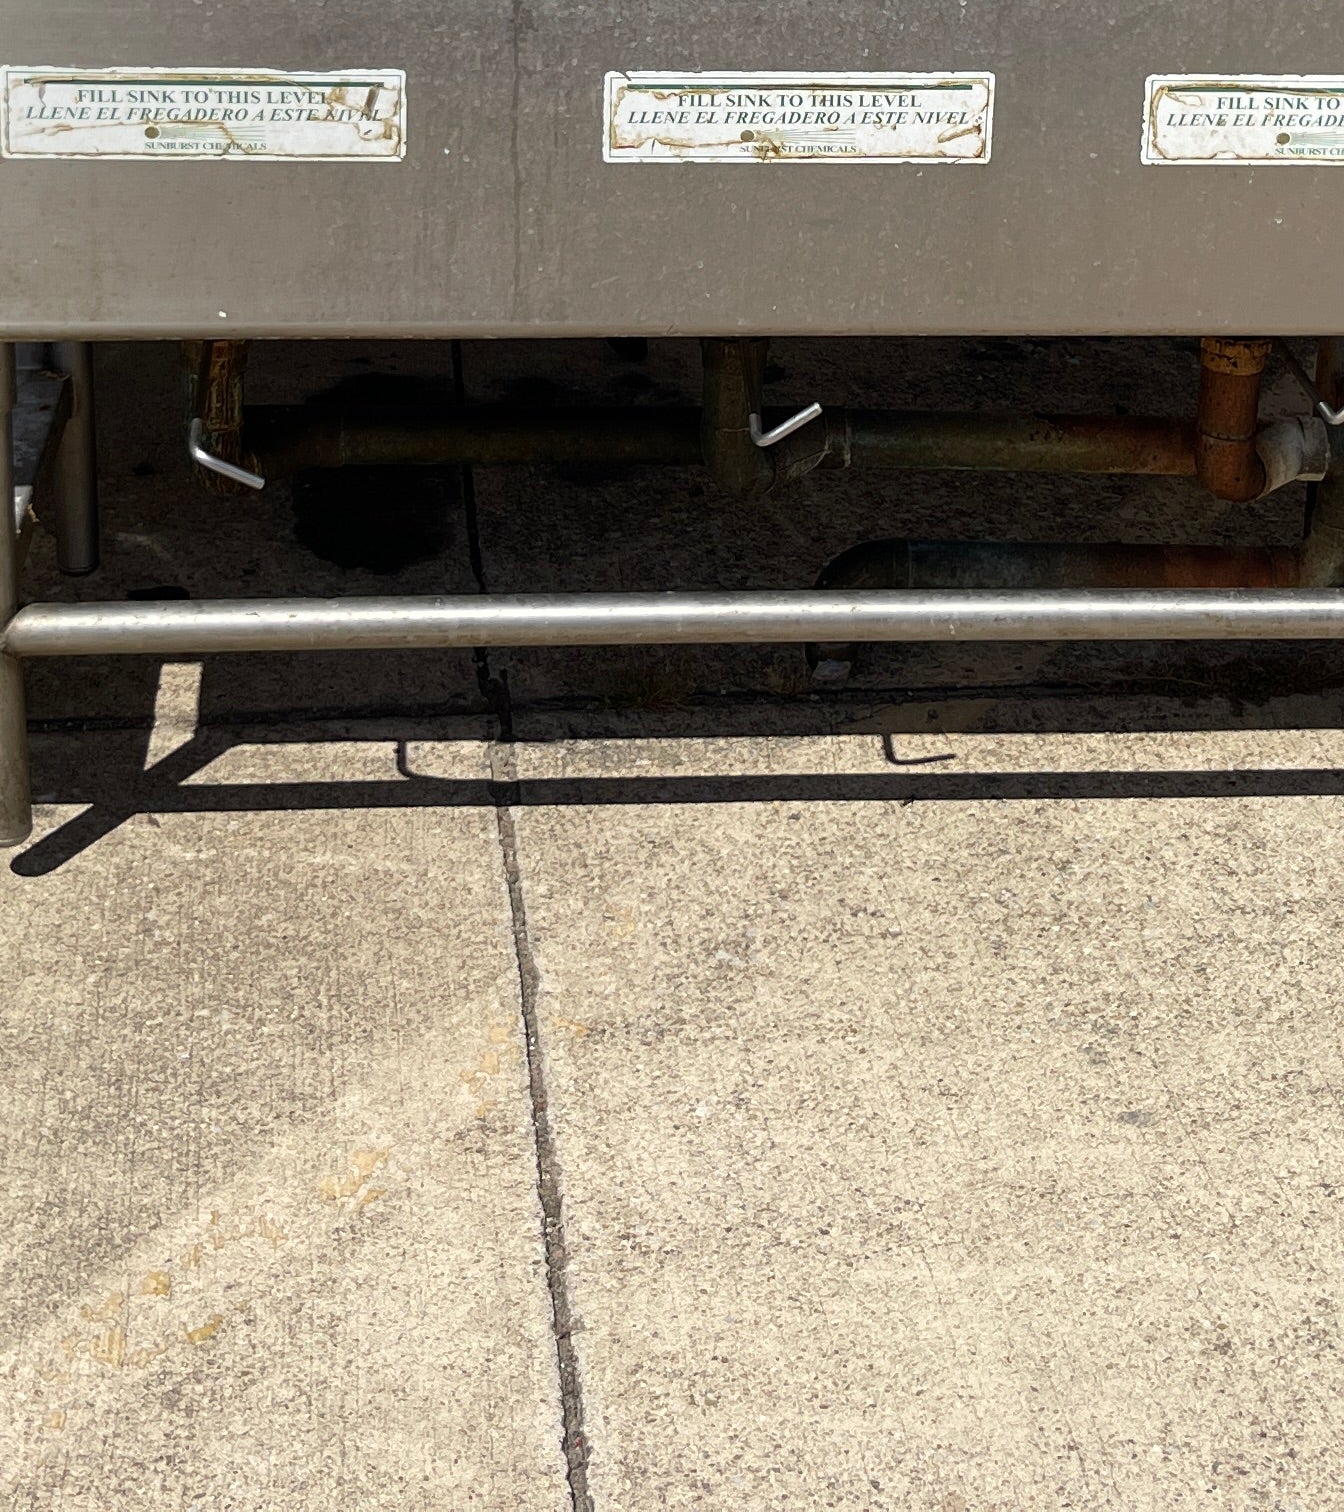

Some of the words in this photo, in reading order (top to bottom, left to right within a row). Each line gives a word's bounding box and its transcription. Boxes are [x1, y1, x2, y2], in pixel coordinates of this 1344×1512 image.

[77, 89, 124, 105] FILL
[127, 89, 174, 105] SINK
[181, 89, 208, 105] TO
[215, 90, 263, 105] THIS
[677, 94, 721, 109] FILL
[725, 94, 772, 109] SINK
[776, 94, 804, 109] TO
[809, 94, 854, 109] THIS
[858, 94, 923, 109] LEVEL
[1216, 97, 1260, 111] FILL
[1263, 97, 1309, 111] SINK
[1313, 97, 1341, 111] TO
[26, 106, 91, 120] LLENE
[96, 106, 122, 120] EL
[127, 106, 249, 122] FREGADERO
[250, 107, 264, 121] A
[269, 107, 318, 122] ESTE
[626, 111, 689, 124] LLENE
[694, 111, 720, 124] EL
[723, 111, 842, 125] FREGADERO
[843, 112, 857, 125] A
[860, 112, 908, 126] ESTE
[912, 112, 971, 126] NIVEL
[1166, 114, 1227, 127] LLENE
[1233, 114, 1257, 127] EL
[144, 141, 201, 151] SUNBURST
[795, 145, 857, 154] CHEMICALS
[1275, 147, 1328, 156] SUNBURST
